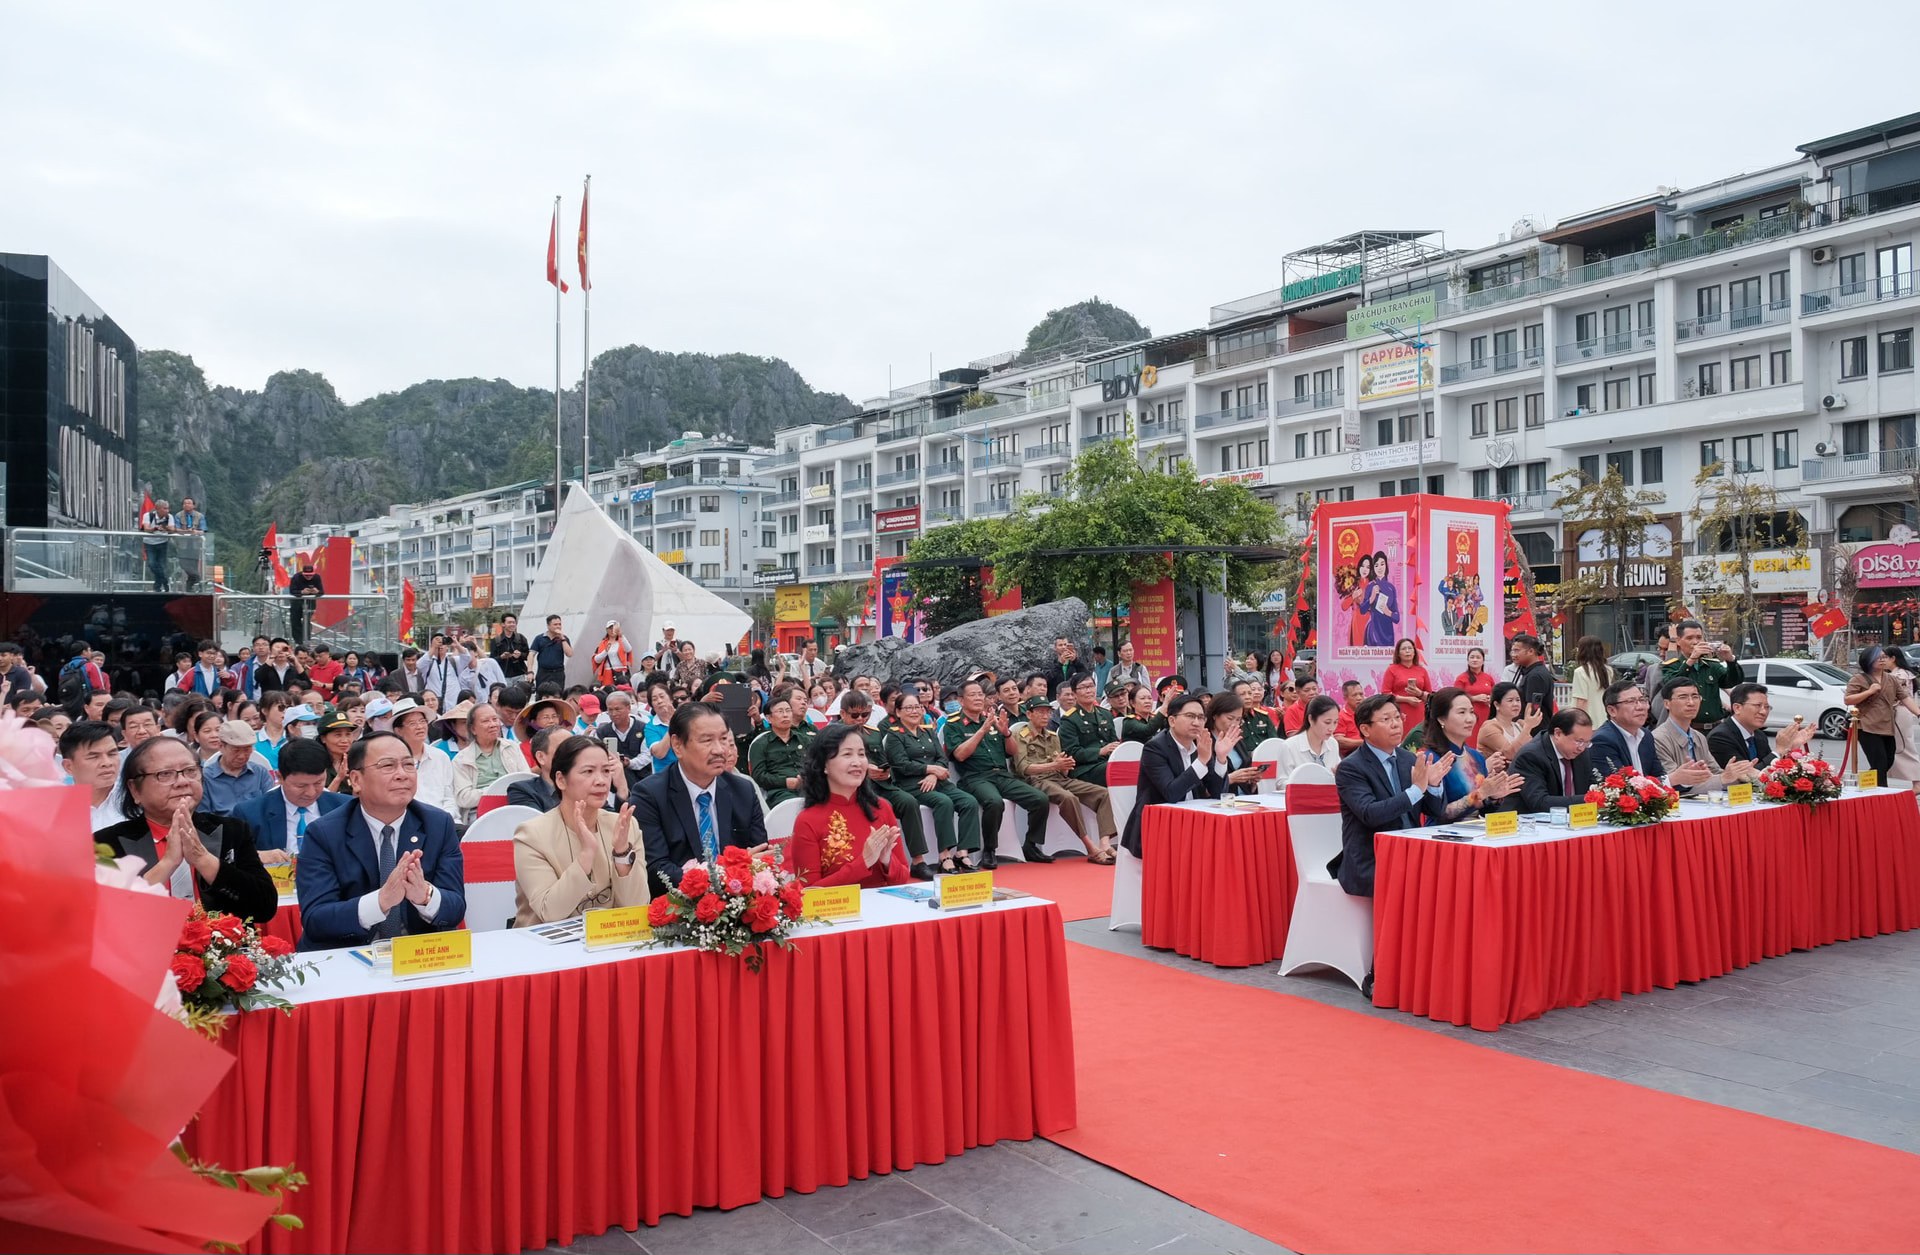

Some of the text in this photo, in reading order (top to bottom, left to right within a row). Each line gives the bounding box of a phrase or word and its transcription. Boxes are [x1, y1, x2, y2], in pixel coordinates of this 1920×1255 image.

[1366, 308, 1387, 318] CHUA
[1102, 373, 1142, 402] BIDV
[1365, 450, 1387, 458] THANH
[1456, 554, 1470, 564] XVI
[1858, 552, 1905, 579] pisa
[1612, 563, 1667, 588] CHUNG
[1338, 648, 1351, 656] NGÀY
[1360, 646, 1371, 656] CỦA
[1371, 647, 1384, 656] TOÀN
[947, 884, 958, 893] TRẦN
[826, 897, 842, 905] THANH
[437, 945, 449, 954] ANH
